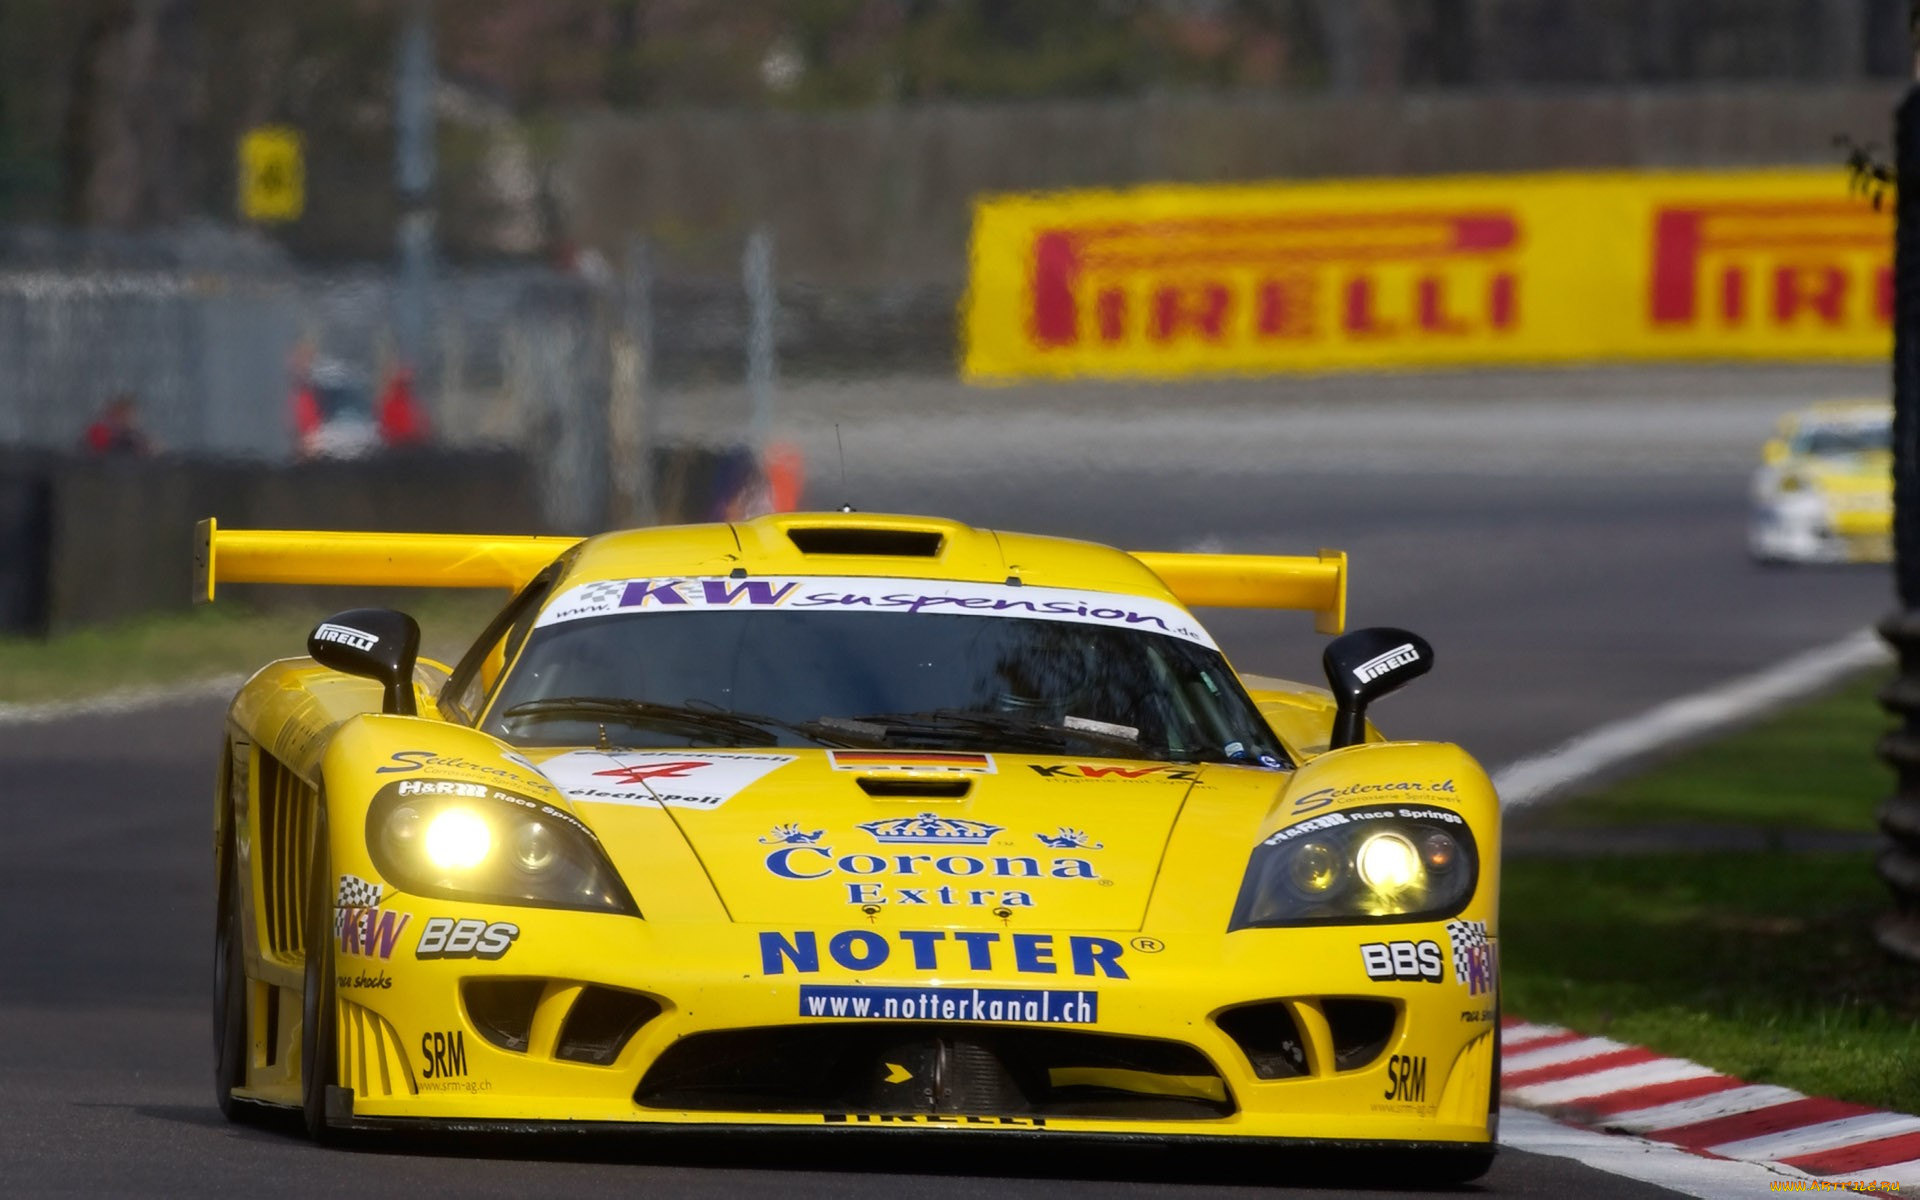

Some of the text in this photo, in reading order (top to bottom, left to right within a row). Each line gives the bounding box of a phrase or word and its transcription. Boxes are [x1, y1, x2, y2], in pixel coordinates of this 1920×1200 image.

[1033, 210, 1518, 344] PIRELLI
[314, 623, 379, 652] PIRELLI
[1353, 643, 1420, 684] PIRELLI
[1027, 764, 1204, 785] KWZ
[493, 791, 534, 808] Race
[1291, 779, 1456, 816] Seilercar.ch
[1350, 811, 1395, 820] Race
[1399, 809, 1463, 824] Springs
[766, 846, 1101, 880] Corona
[846, 882, 1037, 907] Extra
[341, 908, 412, 961] KW
[415, 917, 520, 961] BBS
[758, 930, 1130, 980] NOTTER
[1359, 940, 1444, 984] BBS
[353, 969, 393, 990] shocks
[807, 988, 1092, 1024] www.notterkanal.ch
[421, 1031, 468, 1079] SRM
[417, 1079, 492, 1095] www.srm-ag.ch
[1384, 1054, 1427, 1102] SRM
